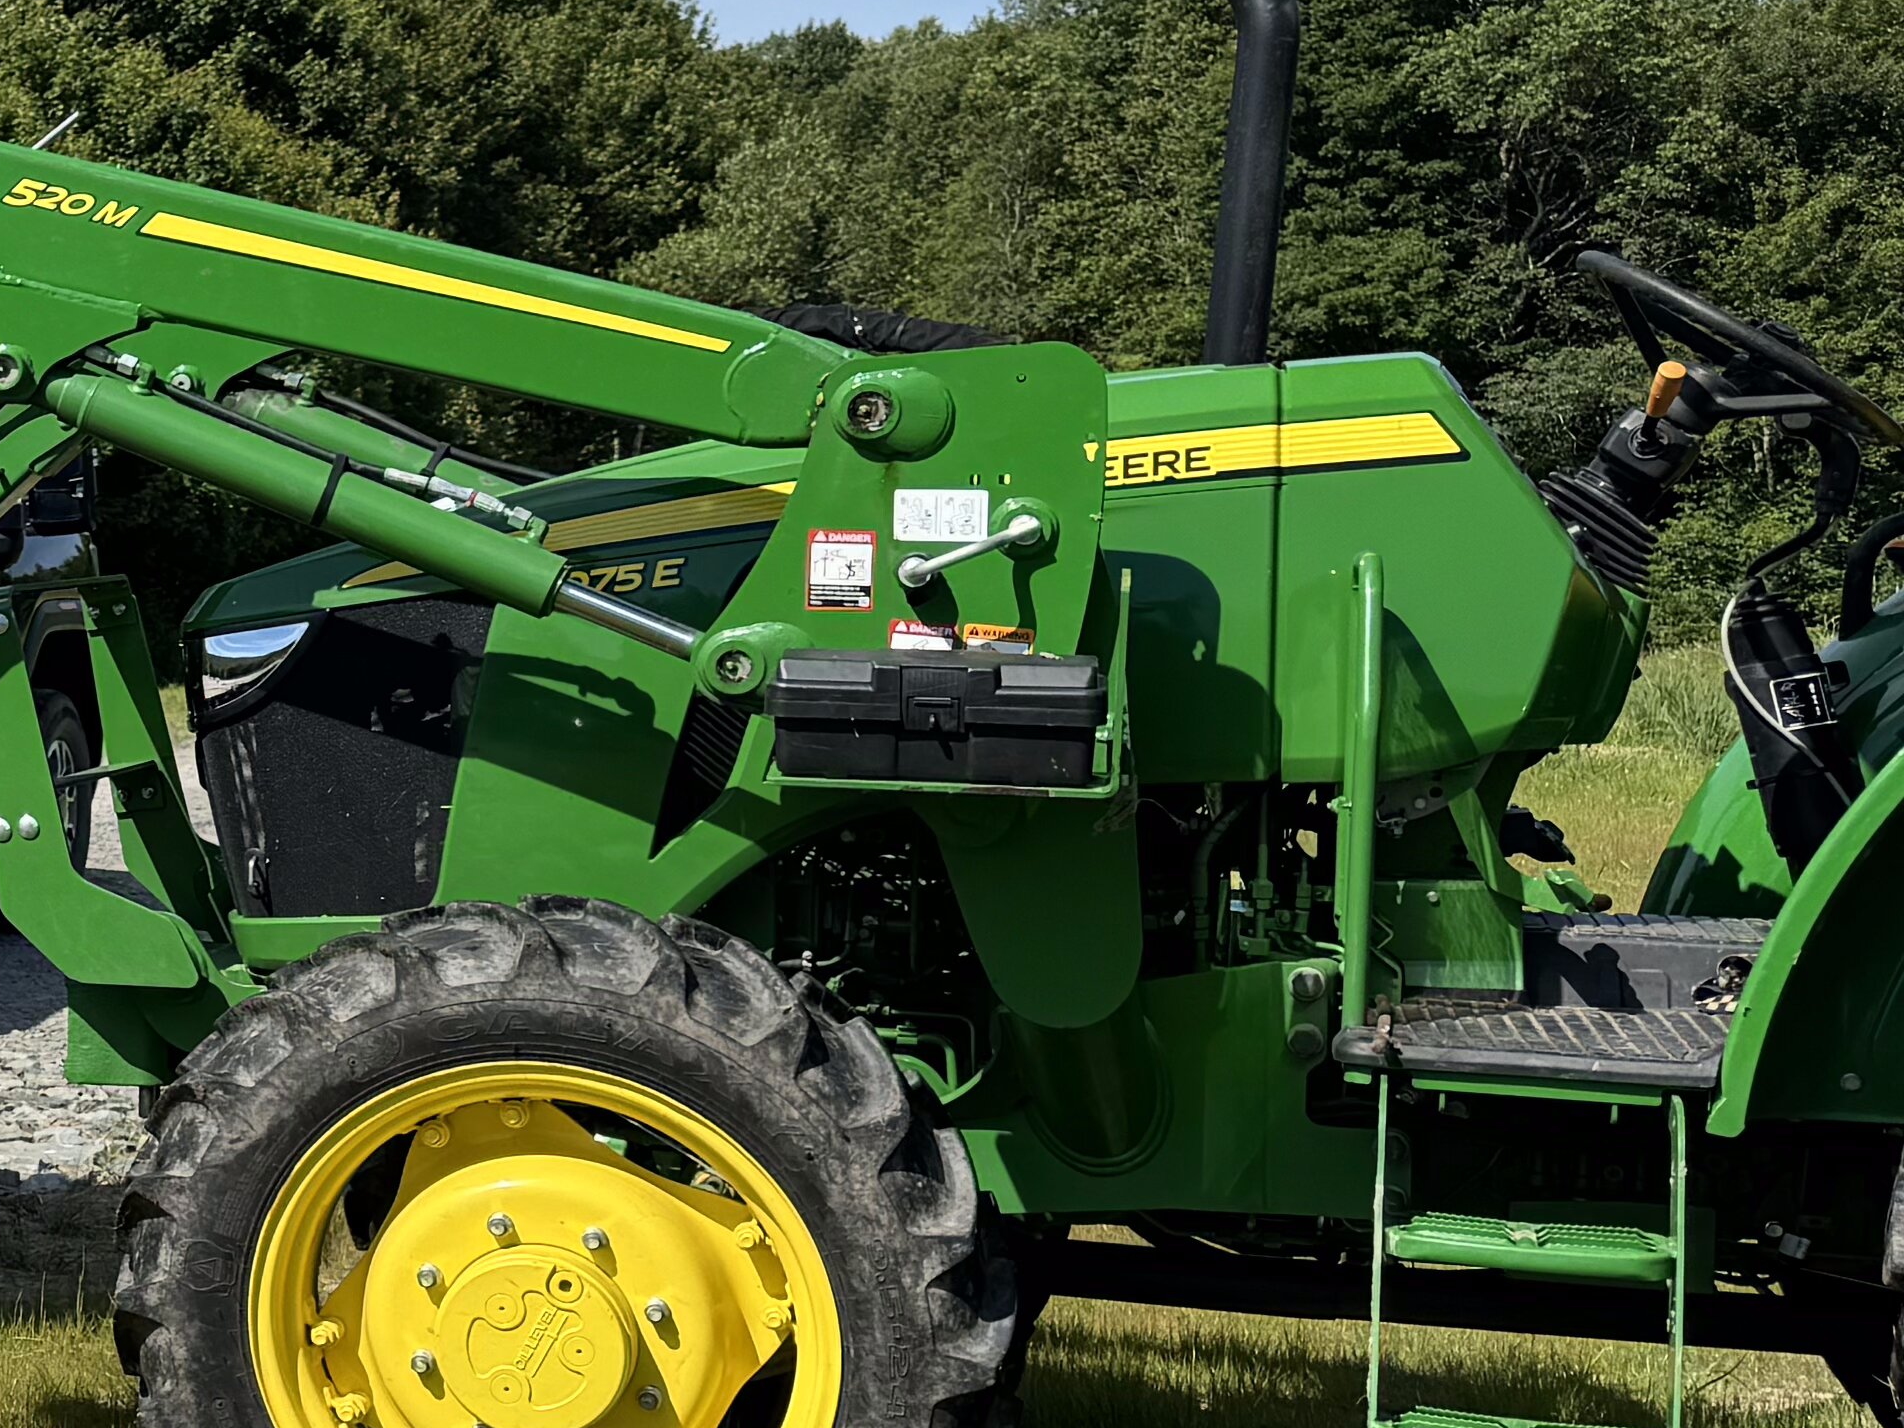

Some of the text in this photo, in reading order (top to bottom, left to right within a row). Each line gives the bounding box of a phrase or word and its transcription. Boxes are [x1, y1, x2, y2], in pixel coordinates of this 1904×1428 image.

[1, 177, 96, 216] 520
[1105, 445, 1212, 481] ERE
[828, 532, 872, 544] DANGER
[909, 623, 954, 636] DANGER
[981, 628, 1030, 641] WARNING
